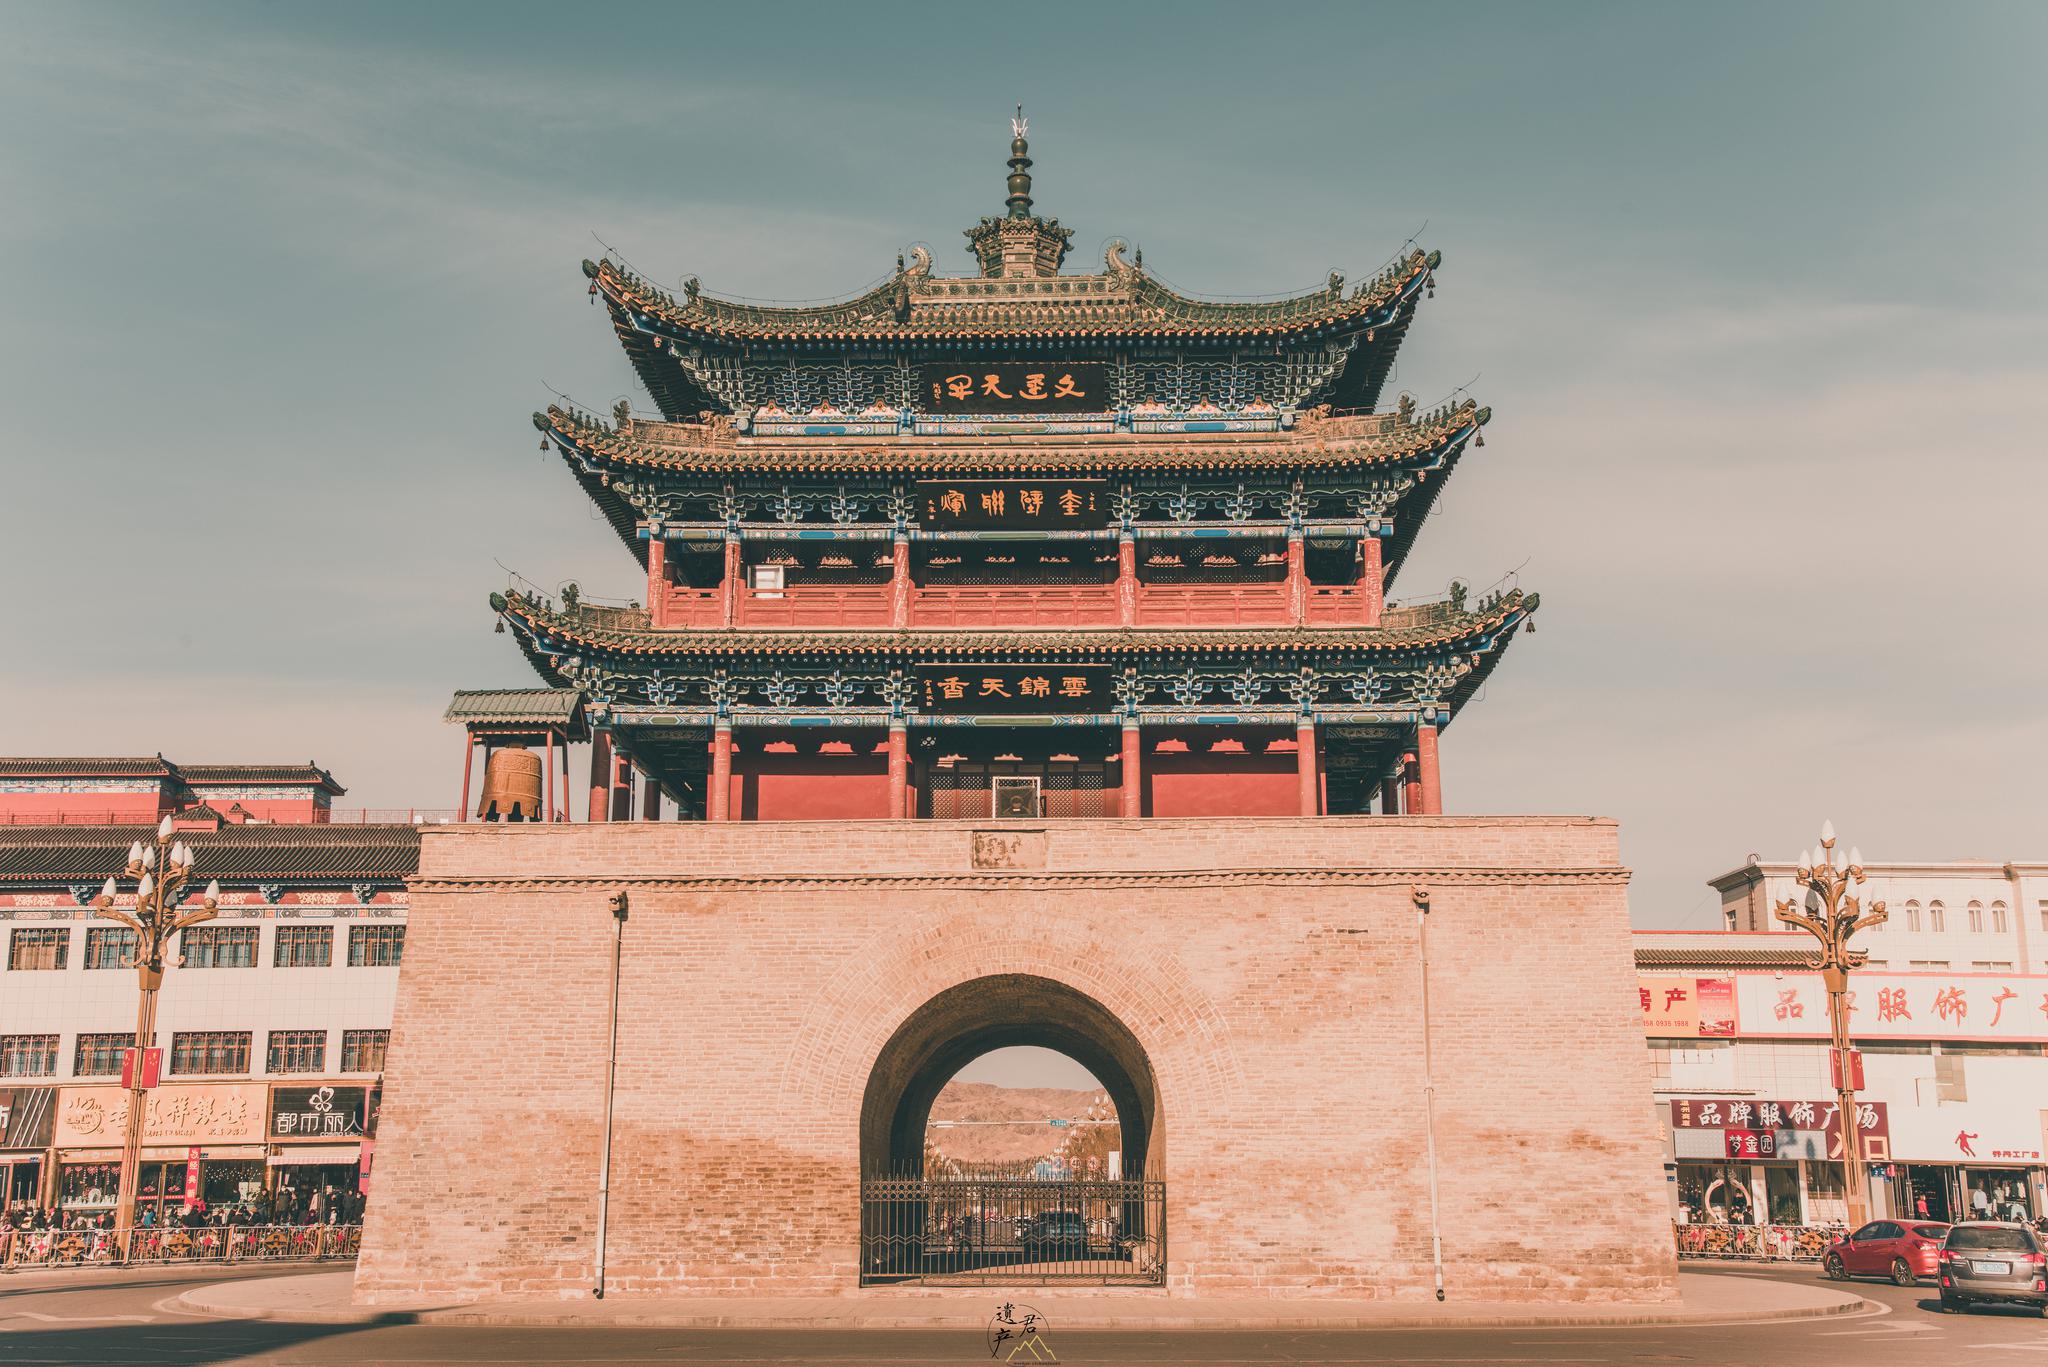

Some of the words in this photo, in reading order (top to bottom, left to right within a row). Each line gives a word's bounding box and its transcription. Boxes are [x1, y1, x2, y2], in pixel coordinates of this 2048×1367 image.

[1774, 986, 2048, 1028] 品服饰广
[277, 1111, 363, 1133] 都市丽人
[1698, 1101, 1879, 1130] 品牌服饰广场
